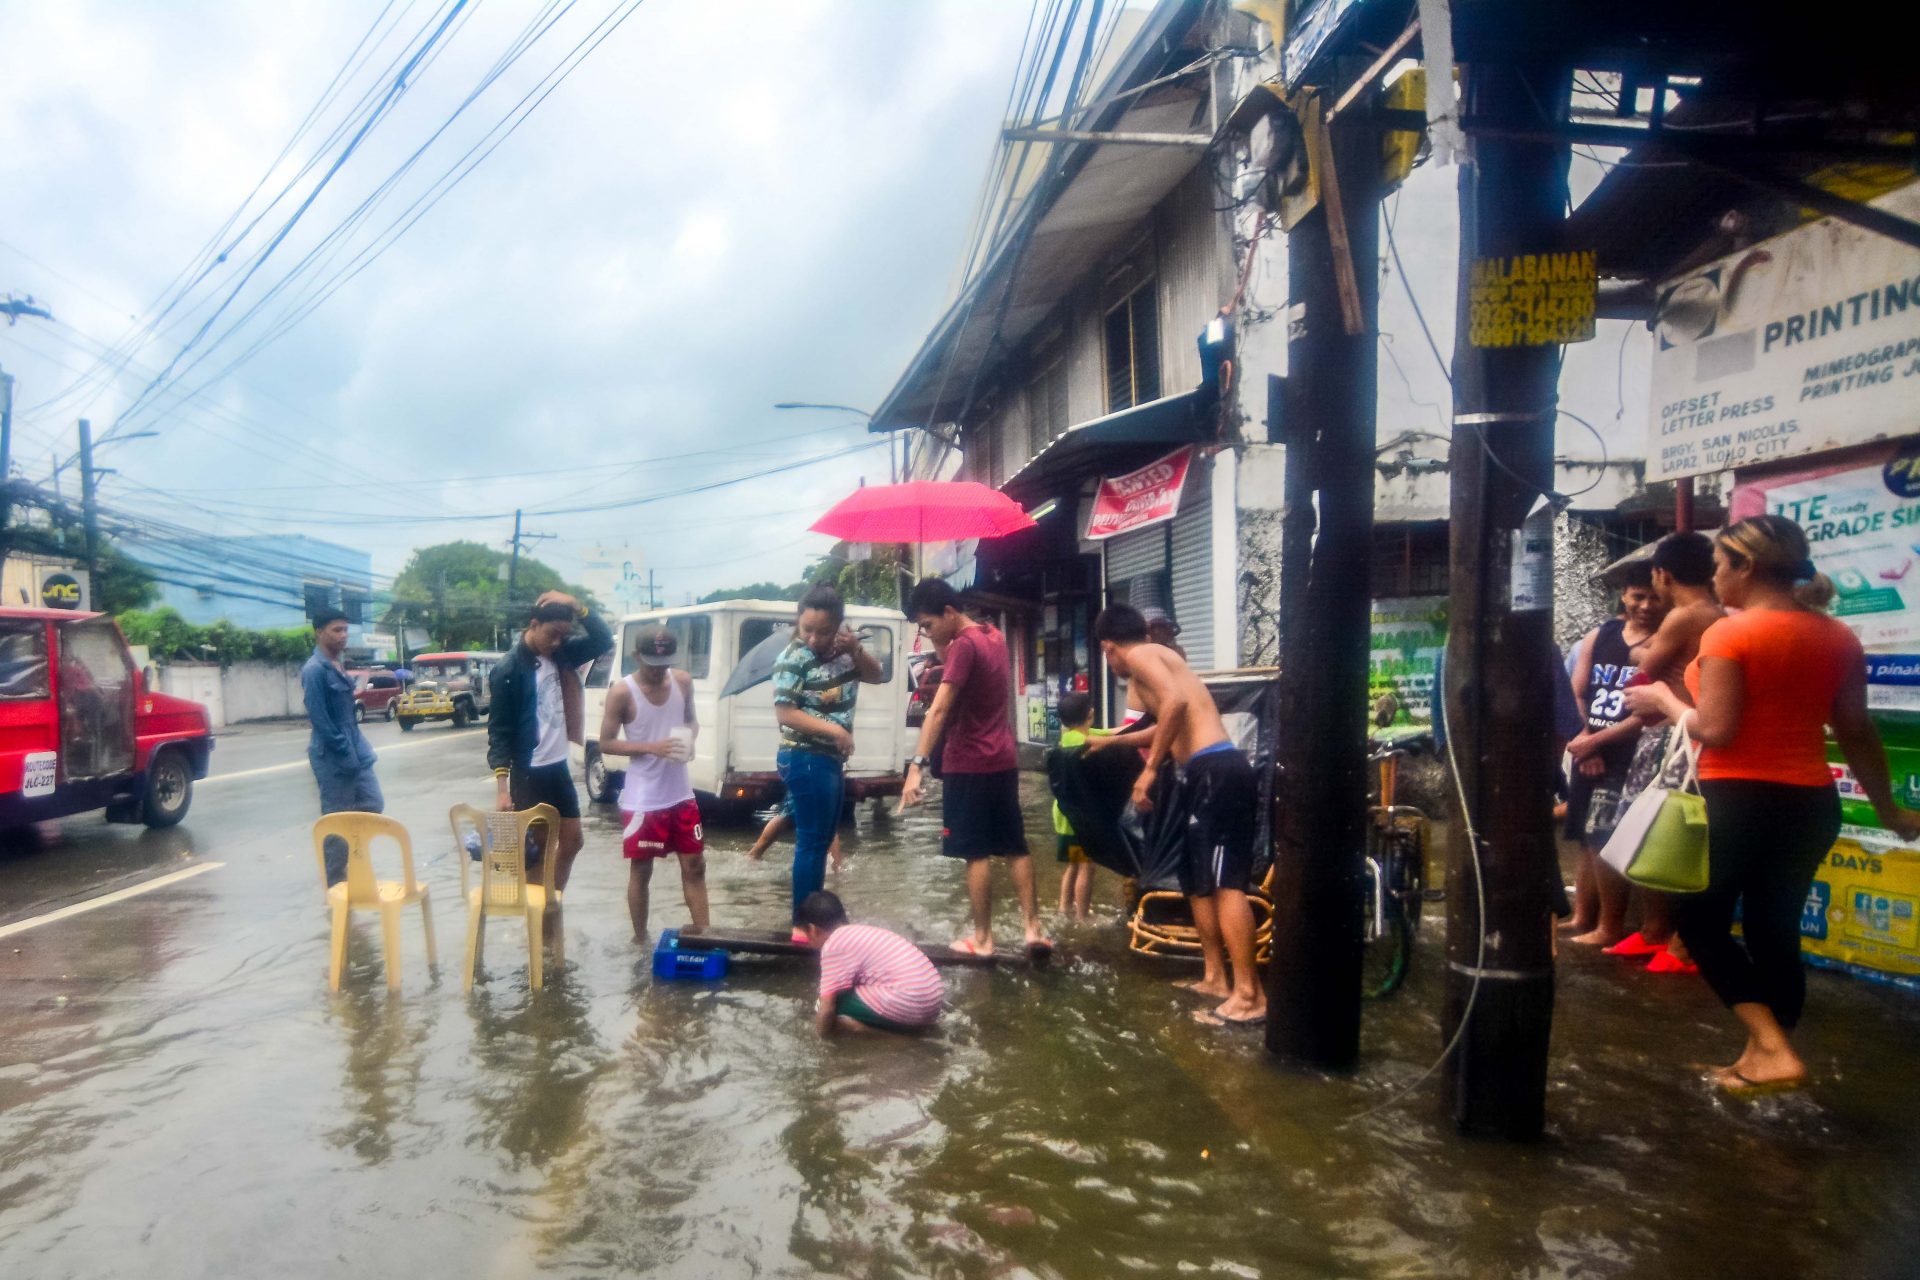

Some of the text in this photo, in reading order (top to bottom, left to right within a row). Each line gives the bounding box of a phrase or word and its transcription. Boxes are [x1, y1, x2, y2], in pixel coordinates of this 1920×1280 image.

[1800, 365, 1894, 402] PRINTING
[1662, 391, 1721, 419] OFFSET
[1662, 395, 1775, 436] LETTER PRESS
[1702, 434, 1732, 450] SAN
[1755, 436, 1790, 455] CITY
[1590, 687, 1625, 718] 23
[1831, 853, 1882, 874] DAYS
